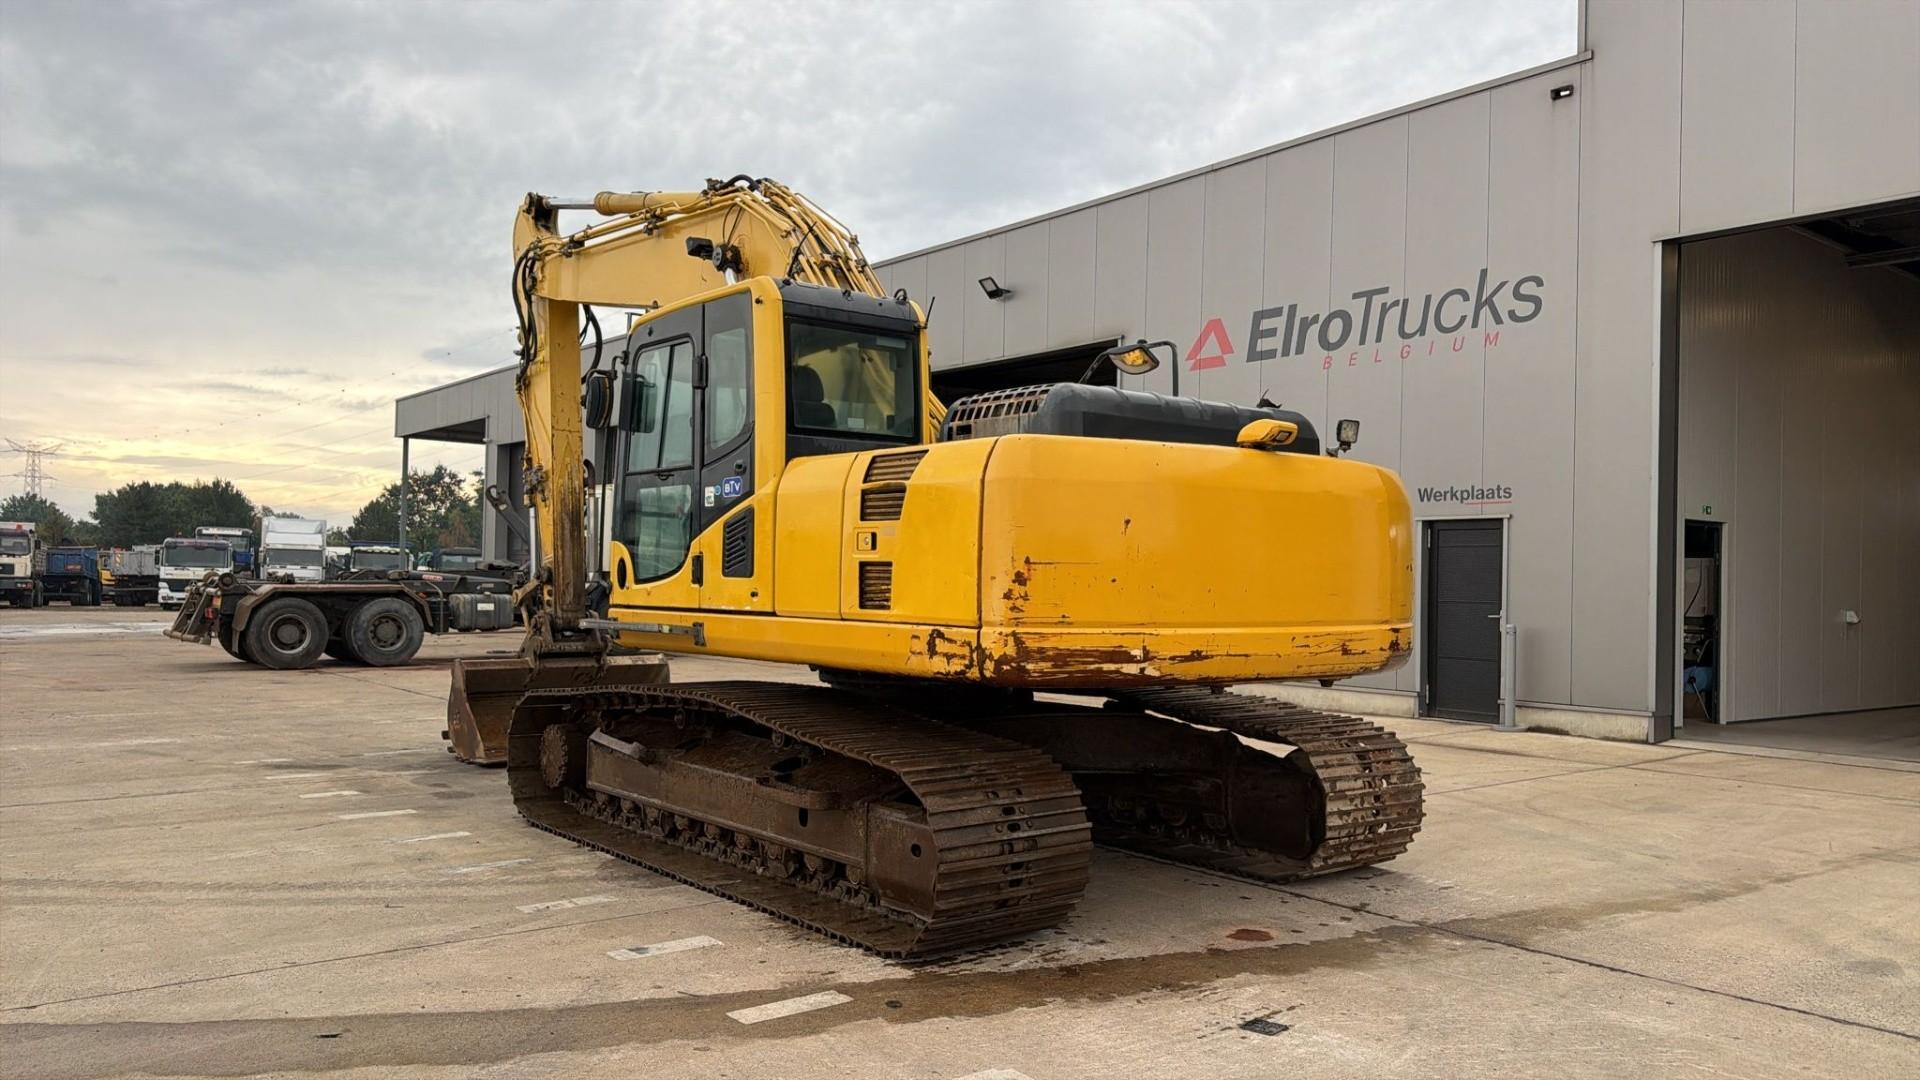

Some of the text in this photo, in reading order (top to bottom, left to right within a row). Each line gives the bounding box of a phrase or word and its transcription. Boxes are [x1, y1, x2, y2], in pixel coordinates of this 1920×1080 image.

[1246, 268, 1545, 363] ElroTrucks
[1323, 331, 1500, 370] BELGIUM
[1418, 484, 1513, 504] Werkplaats
